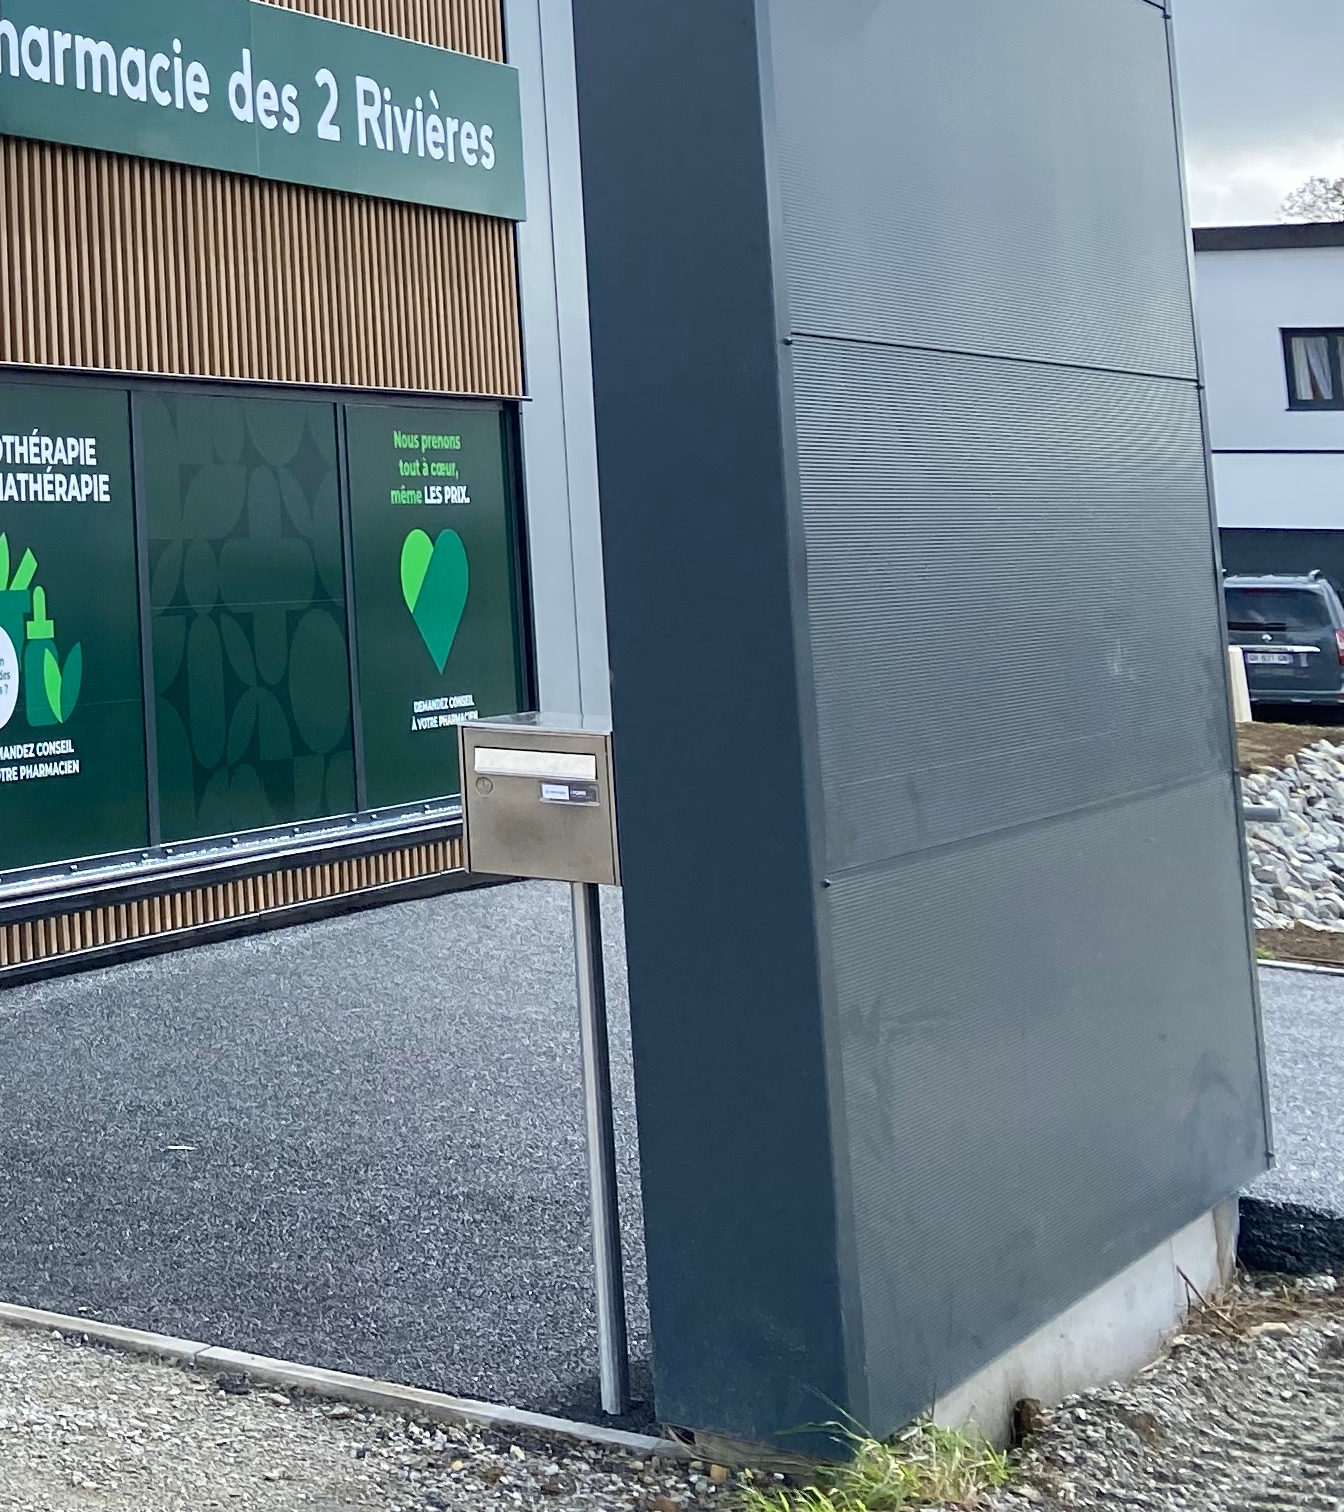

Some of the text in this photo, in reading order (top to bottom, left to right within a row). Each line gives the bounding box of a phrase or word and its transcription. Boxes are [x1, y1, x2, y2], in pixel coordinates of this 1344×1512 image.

[228, 49, 300, 134] des
[316, 68, 340, 141] 2
[356, 75, 496, 170] Rivières
[393, 430, 461, 453] Nous prenons
[399, 459, 421, 476] tout
[422, 457, 429, 476] à
[391, 484, 470, 504] même LES PRIX.
[4, 683, 9, 694] ?
[414, 698, 449, 713] DEMANDEZ
[417, 716, 438, 730] VOTRE
[36, 739, 75, 757] CONSEIL
[19, 759, 80, 780] PHARMACIEN
